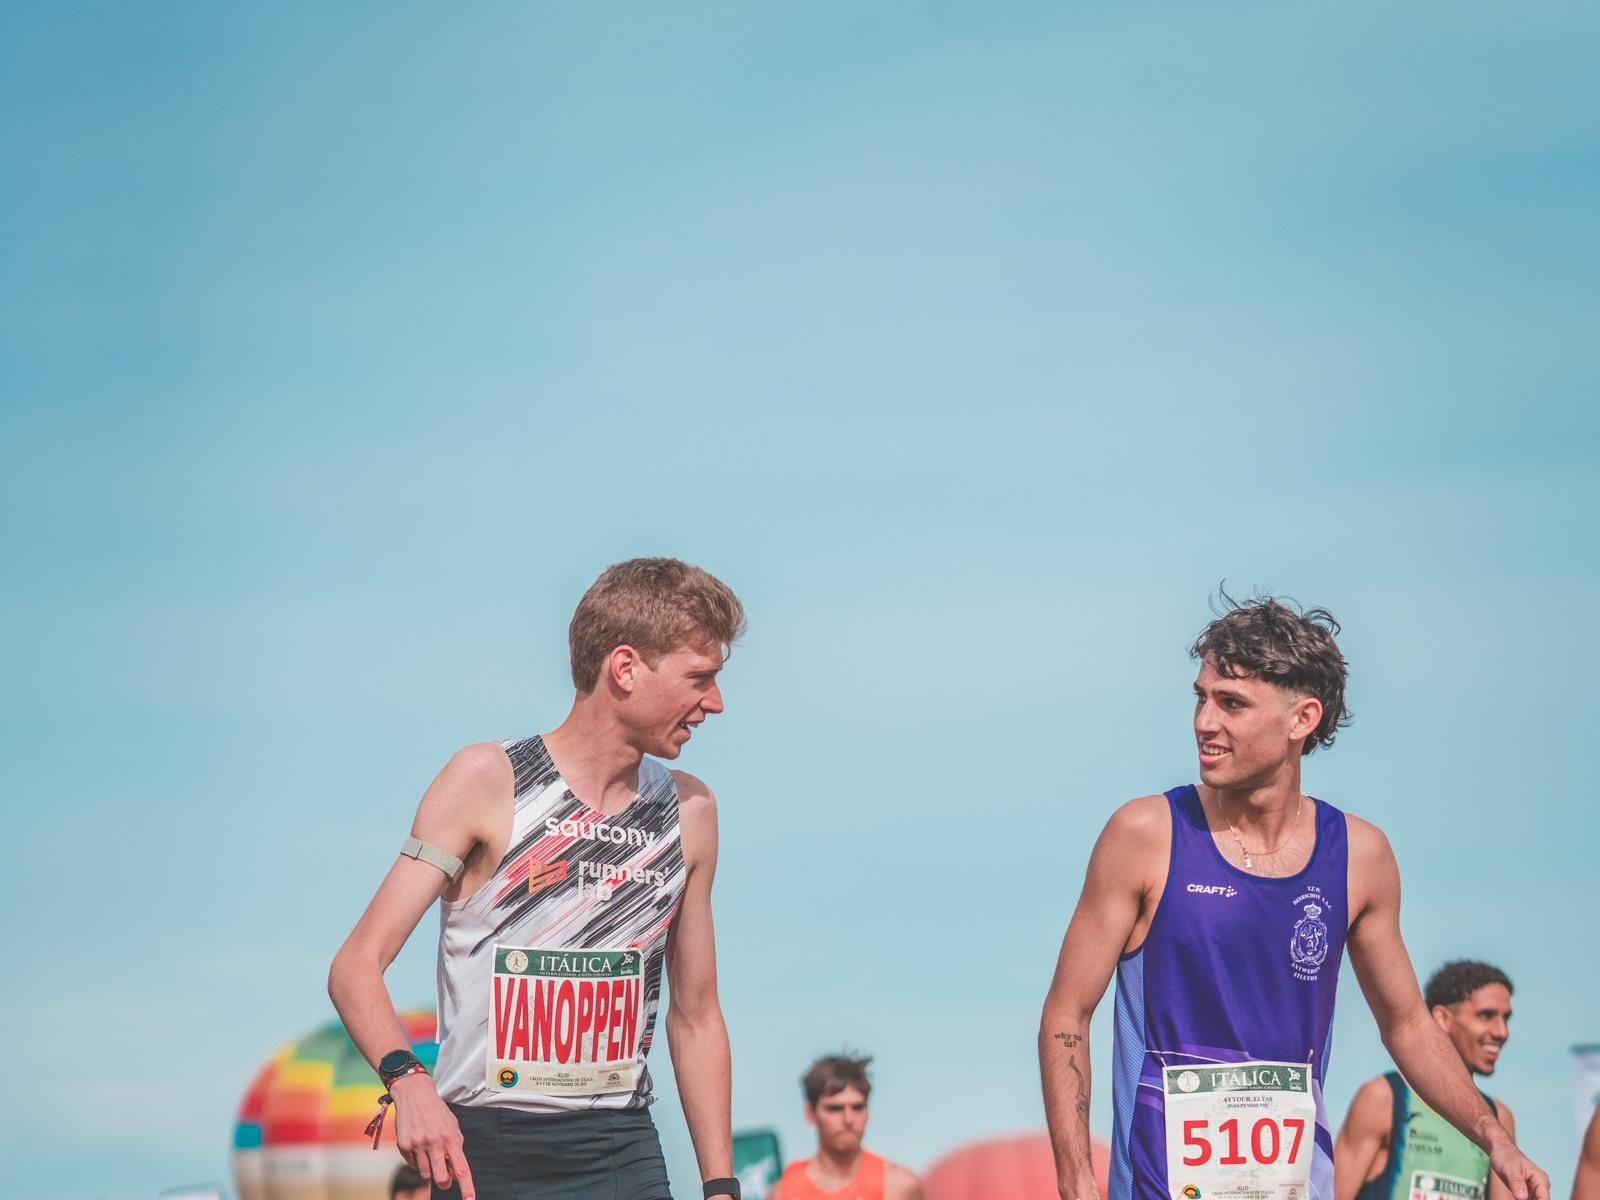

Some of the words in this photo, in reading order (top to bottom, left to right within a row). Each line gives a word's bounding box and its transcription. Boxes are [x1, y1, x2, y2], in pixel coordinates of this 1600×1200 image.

[545, 817, 655, 850] saucony
[578, 860, 670, 887] runners'
[578, 876, 613, 901] lab
[1186, 884, 1227, 895] CRAFT
[540, 953, 612, 973] ITÁLICA
[494, 977, 640, 1064] VANOPPEN
[1054, 1032, 1071, 1041] why
[1211, 1068, 1281, 1087] ITÁLICA
[1183, 1118, 1305, 1166] 5107
